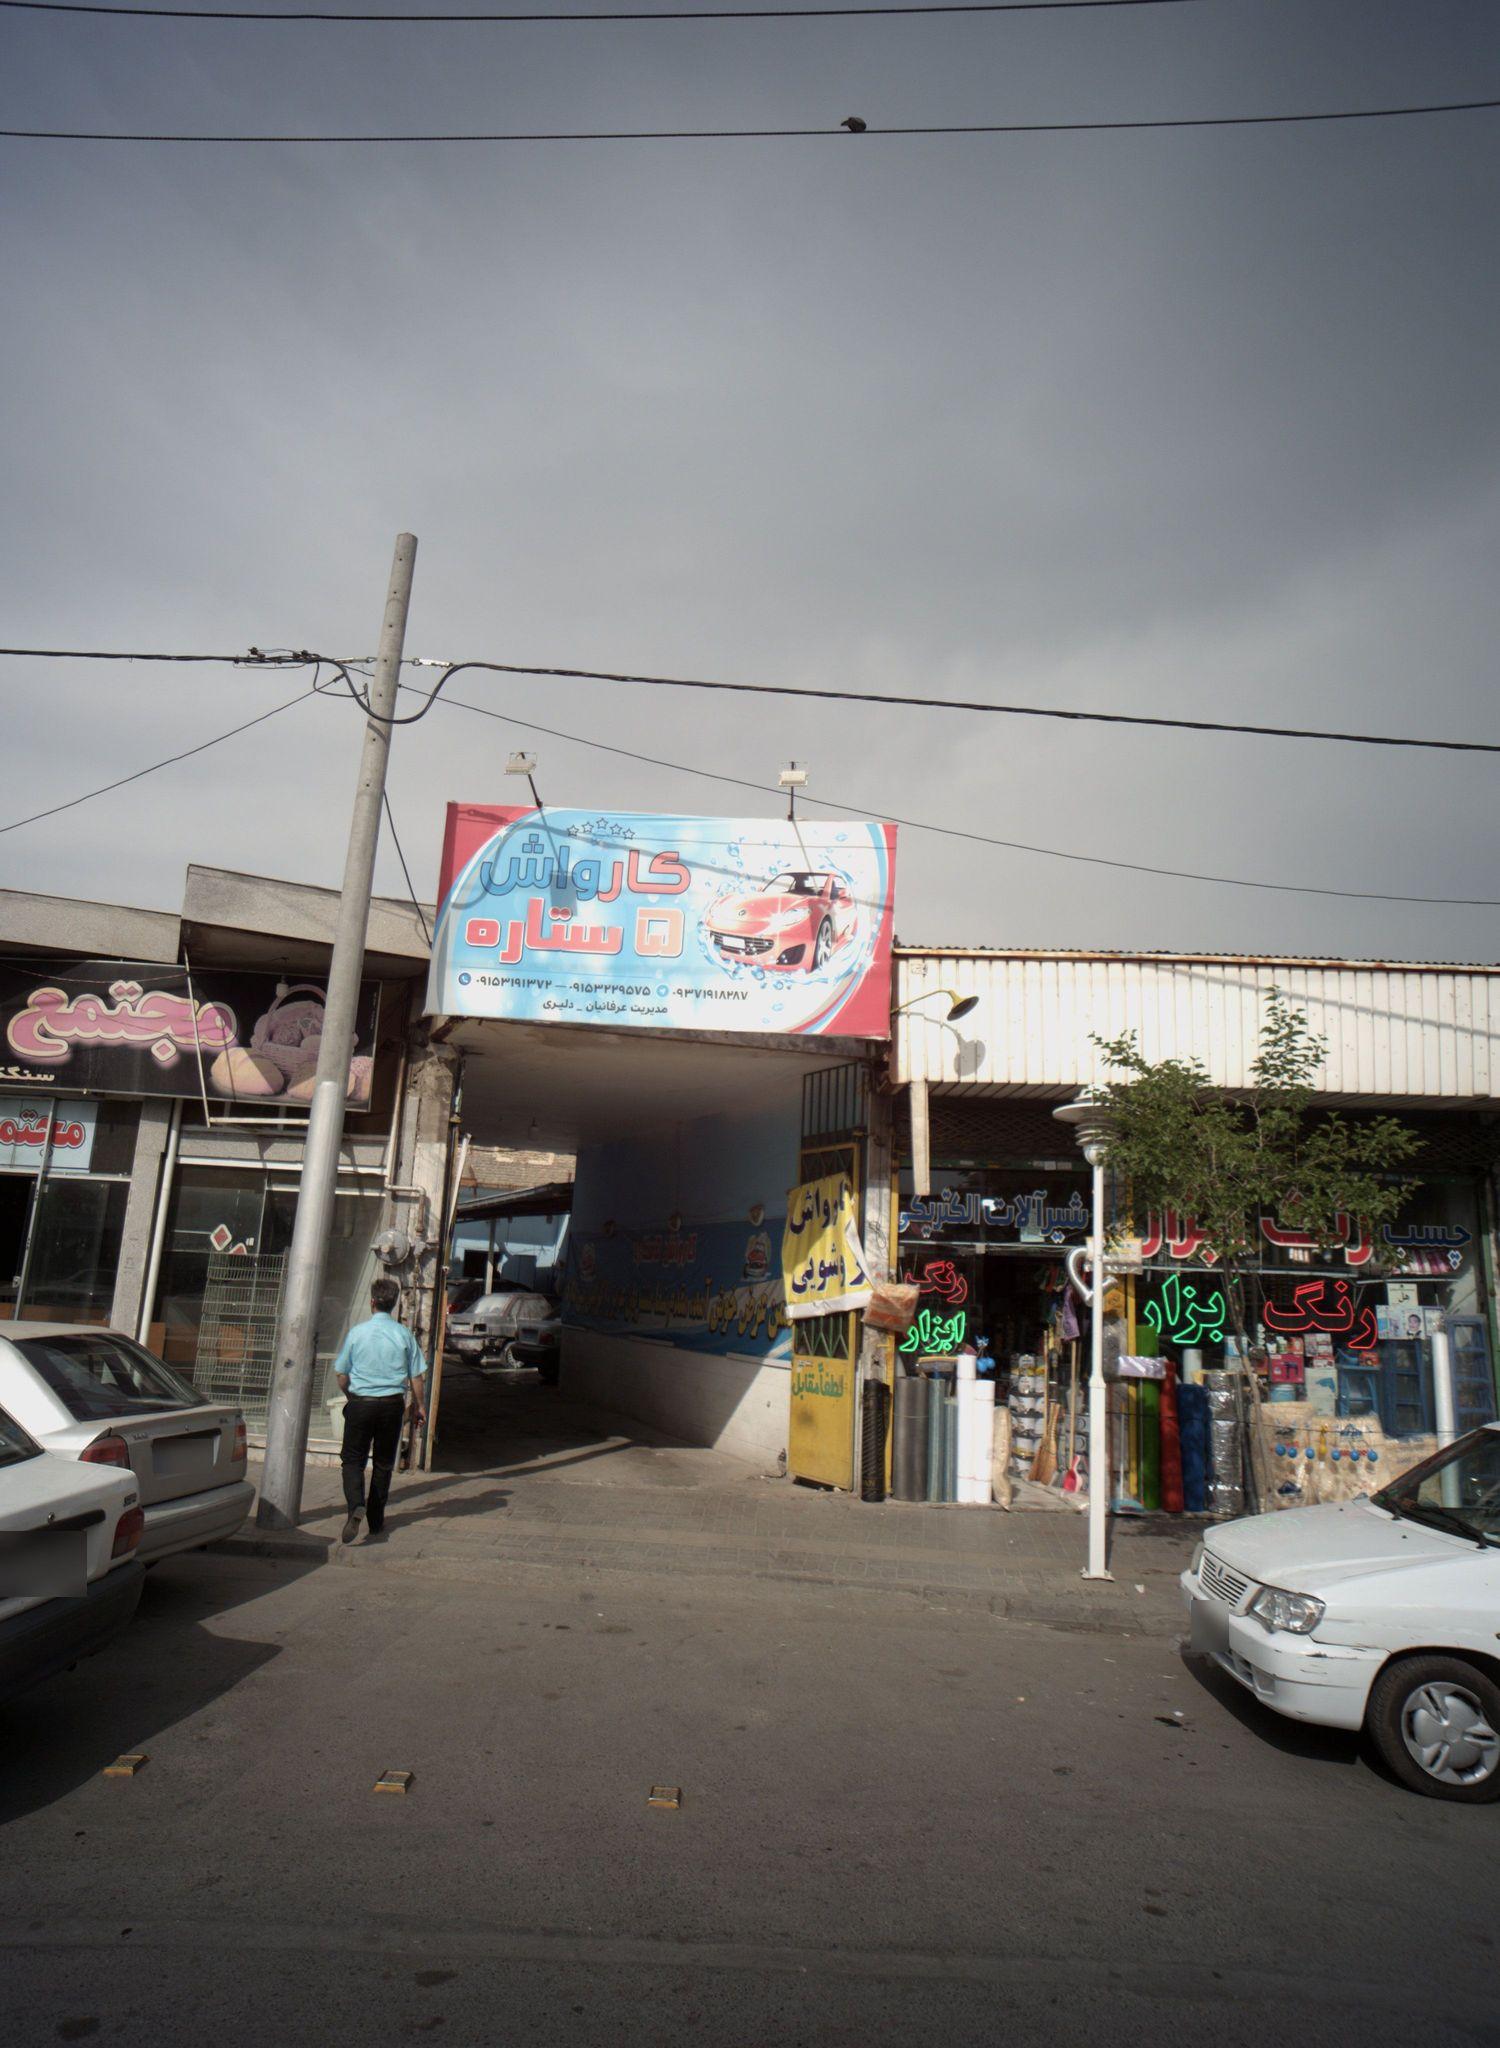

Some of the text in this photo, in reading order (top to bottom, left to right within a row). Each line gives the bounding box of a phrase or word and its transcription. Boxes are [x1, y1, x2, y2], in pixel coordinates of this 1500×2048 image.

[480, 833, 691, 903] کارواش
[465, 897, 684, 964] ۵ ستاره
[7, 980, 237, 1062] مجتمع
[631, 1002, 668, 1015] مدیریت
[904, 1260, 968, 1304] رنگ
[1263, 1280, 1378, 1349] رنگ
[898, 1308, 966, 1353] ابزار
